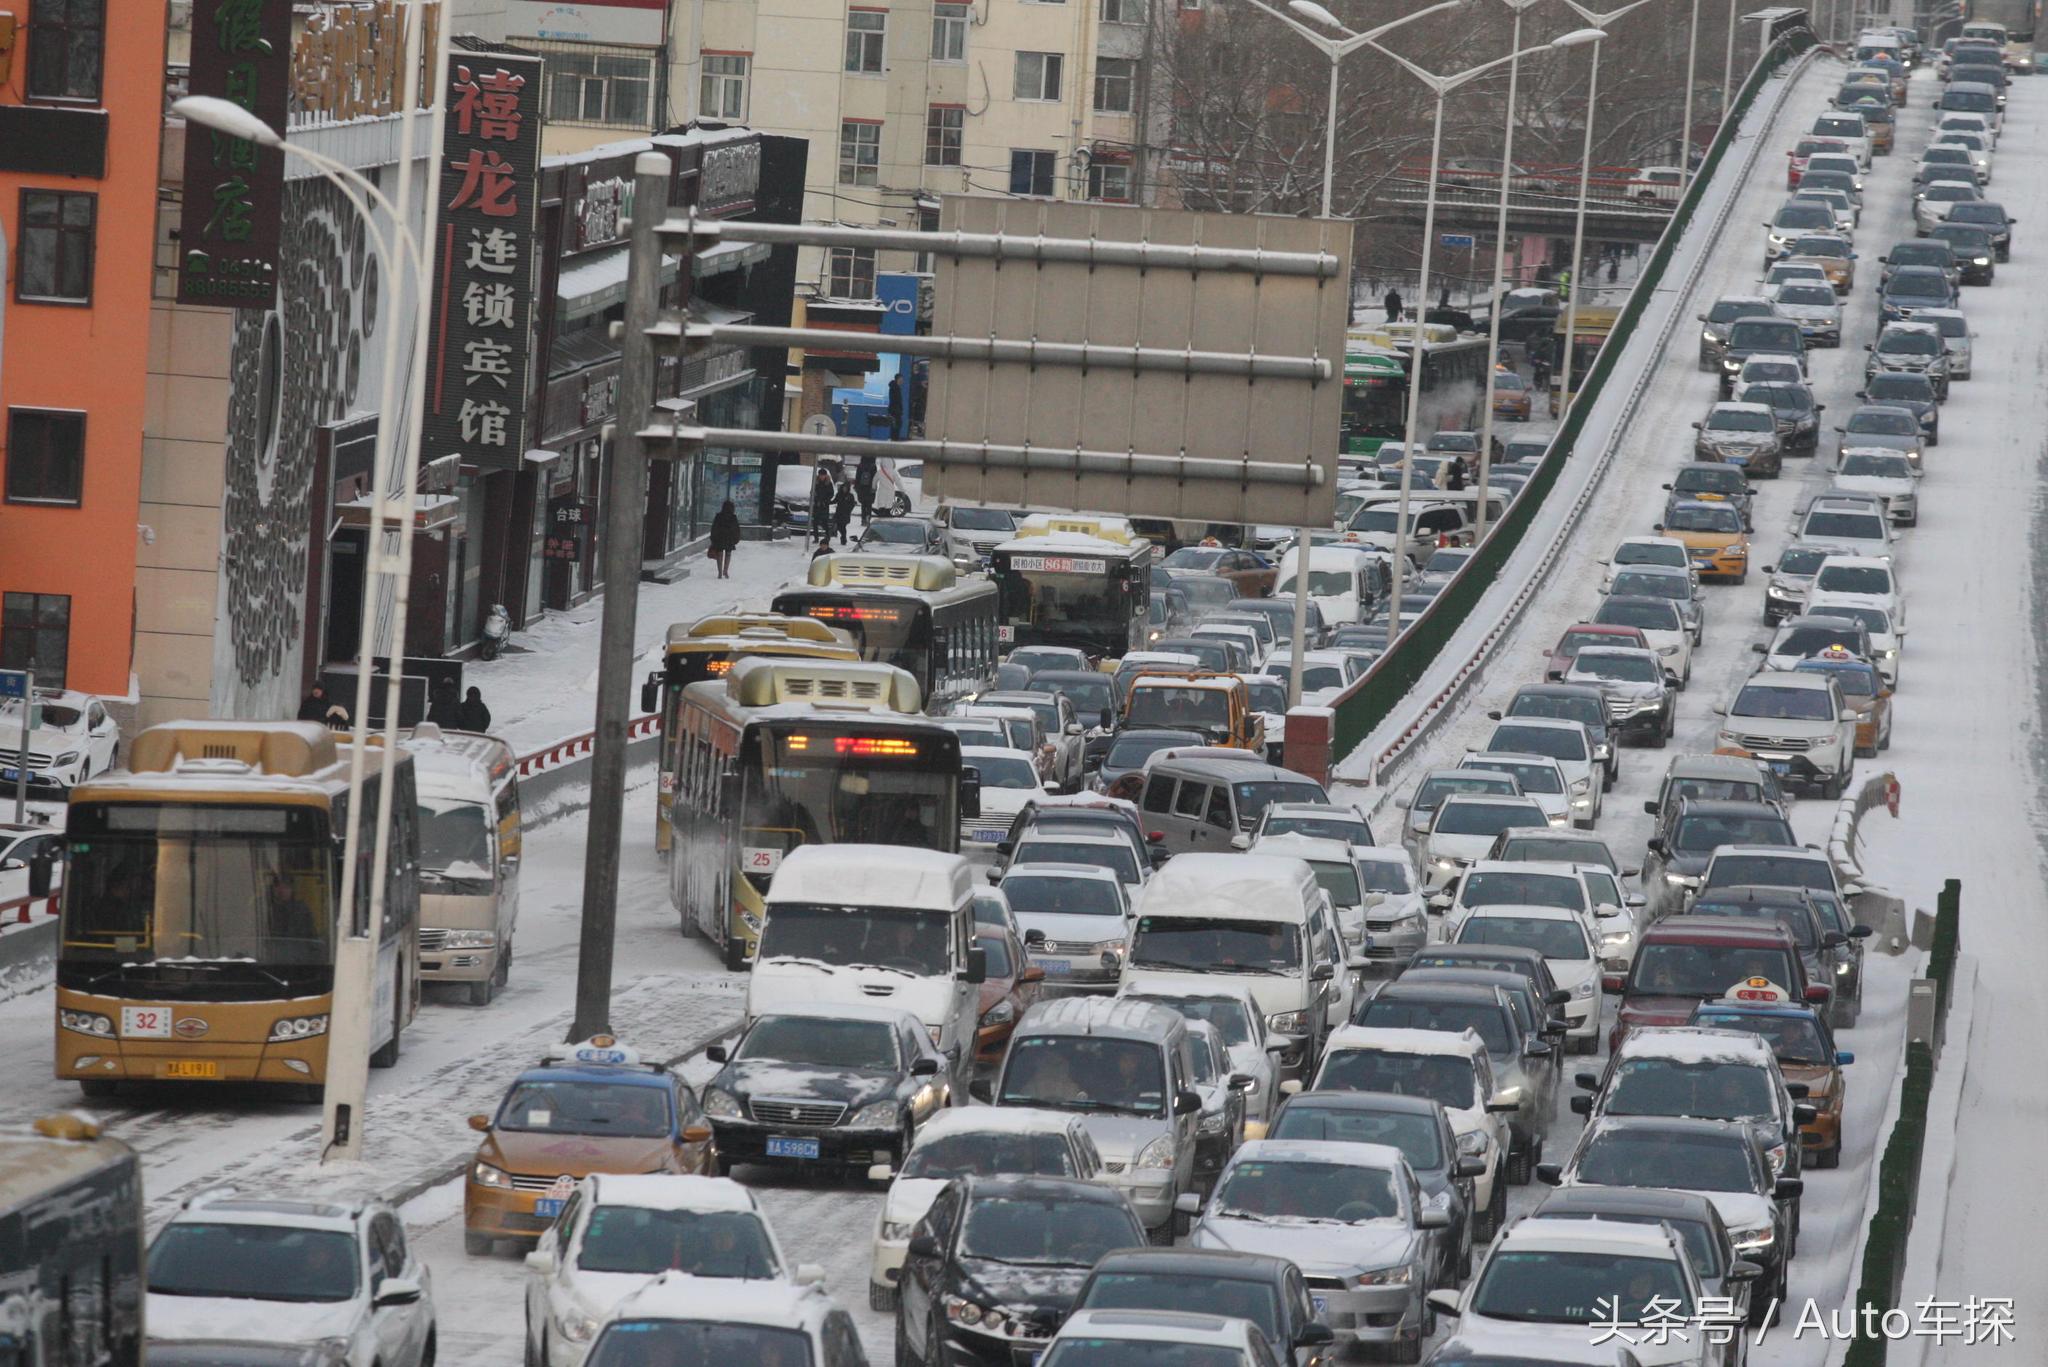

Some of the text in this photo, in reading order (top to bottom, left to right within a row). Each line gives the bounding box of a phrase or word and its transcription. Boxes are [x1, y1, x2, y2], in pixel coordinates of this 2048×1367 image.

[556, 507, 582, 522] 台球
[753, 852, 771, 866] 25
[136, 1012, 158, 1029] 32
